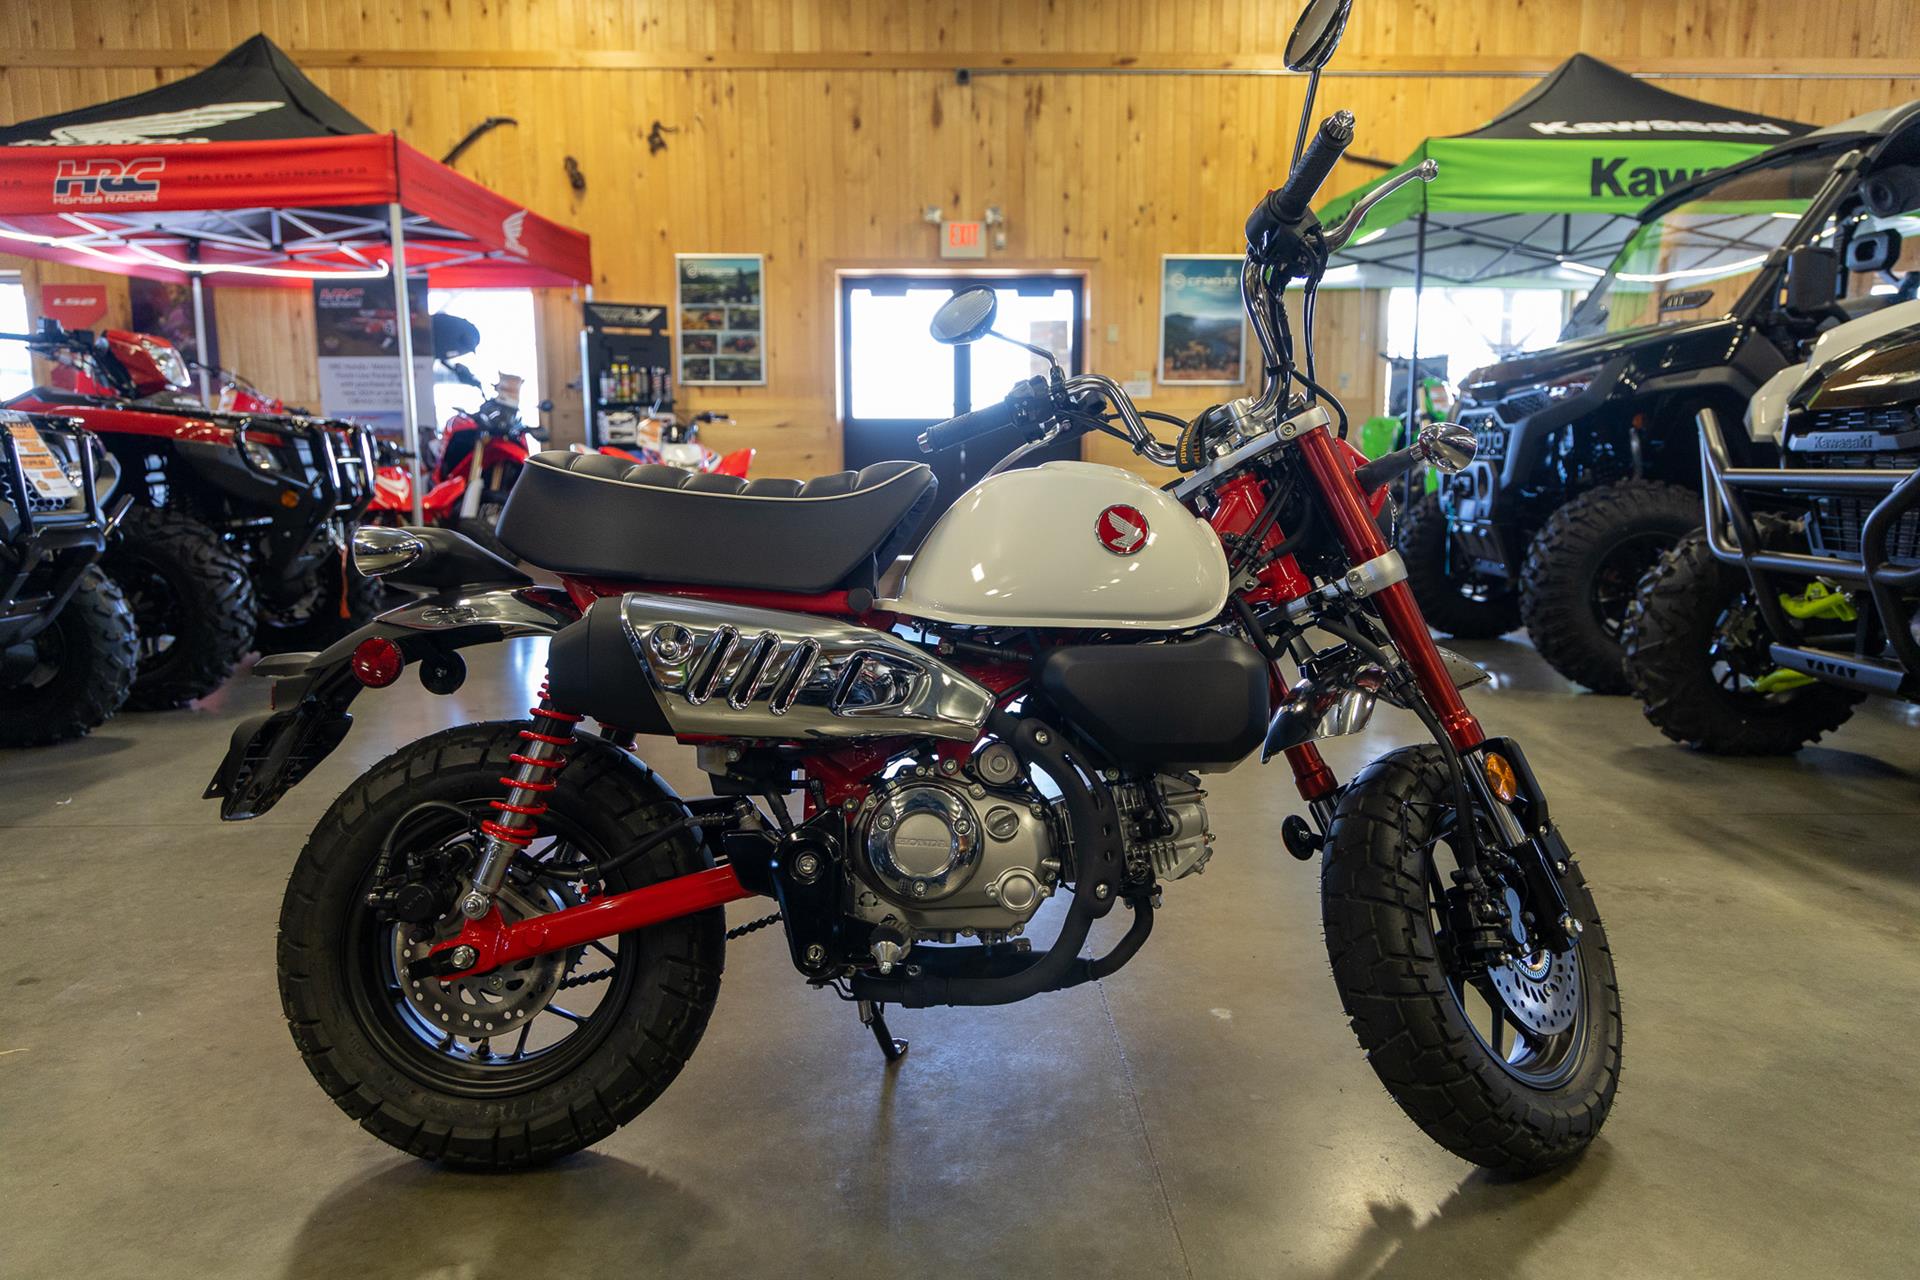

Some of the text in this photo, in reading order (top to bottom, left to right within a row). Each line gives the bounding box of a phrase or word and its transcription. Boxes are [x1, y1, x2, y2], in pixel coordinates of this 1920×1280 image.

[1529, 120, 1791, 136] Kawasaki
[54, 157, 166, 195] HRC
[1590, 157, 1726, 198] Kaw
[949, 223, 979, 248] EXIT
[1814, 435, 1873, 449] Kawasaki
[897, 838, 946, 848] HONDA
